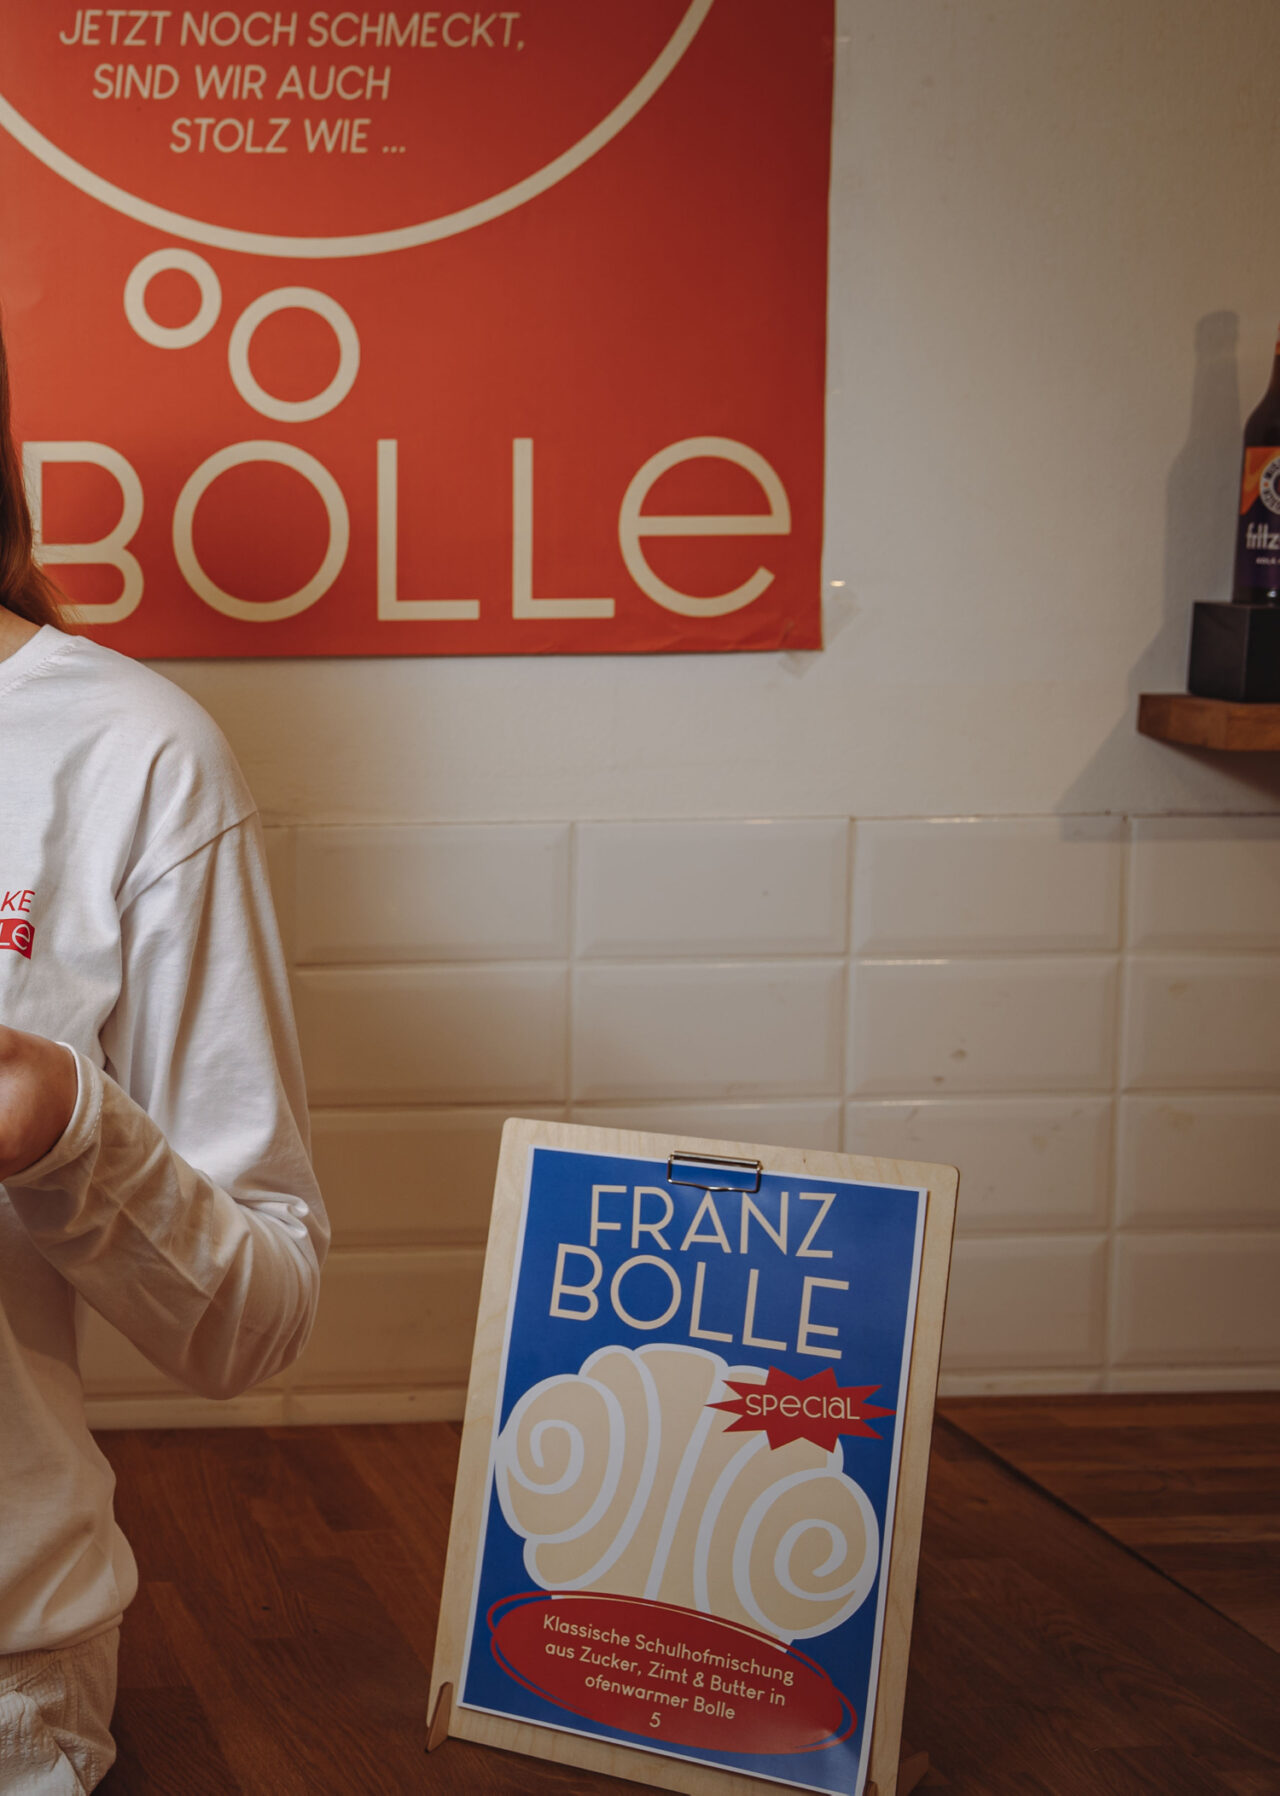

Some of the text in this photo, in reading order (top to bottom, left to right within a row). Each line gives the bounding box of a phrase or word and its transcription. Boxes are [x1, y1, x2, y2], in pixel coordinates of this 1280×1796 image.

[59, 10, 524, 51] JETZT NOCH SCHMECKT,
[93, 63, 391, 101] SIND WIR AUCH
[170, 118, 290, 154] STOLZ
[304, 118, 371, 154] WIE
[588, 1183, 837, 1260] FRANZ
[549, 1243, 850, 1360] BOLLE
[543, 1614, 795, 1687] Klassische Schulhofmischung
[545, 1642, 786, 1706] aus Zucker, Zimt & Butter in
[584, 1674, 736, 1720] ofenwarmer Bolle
[648, 1712, 662, 1728] 5
